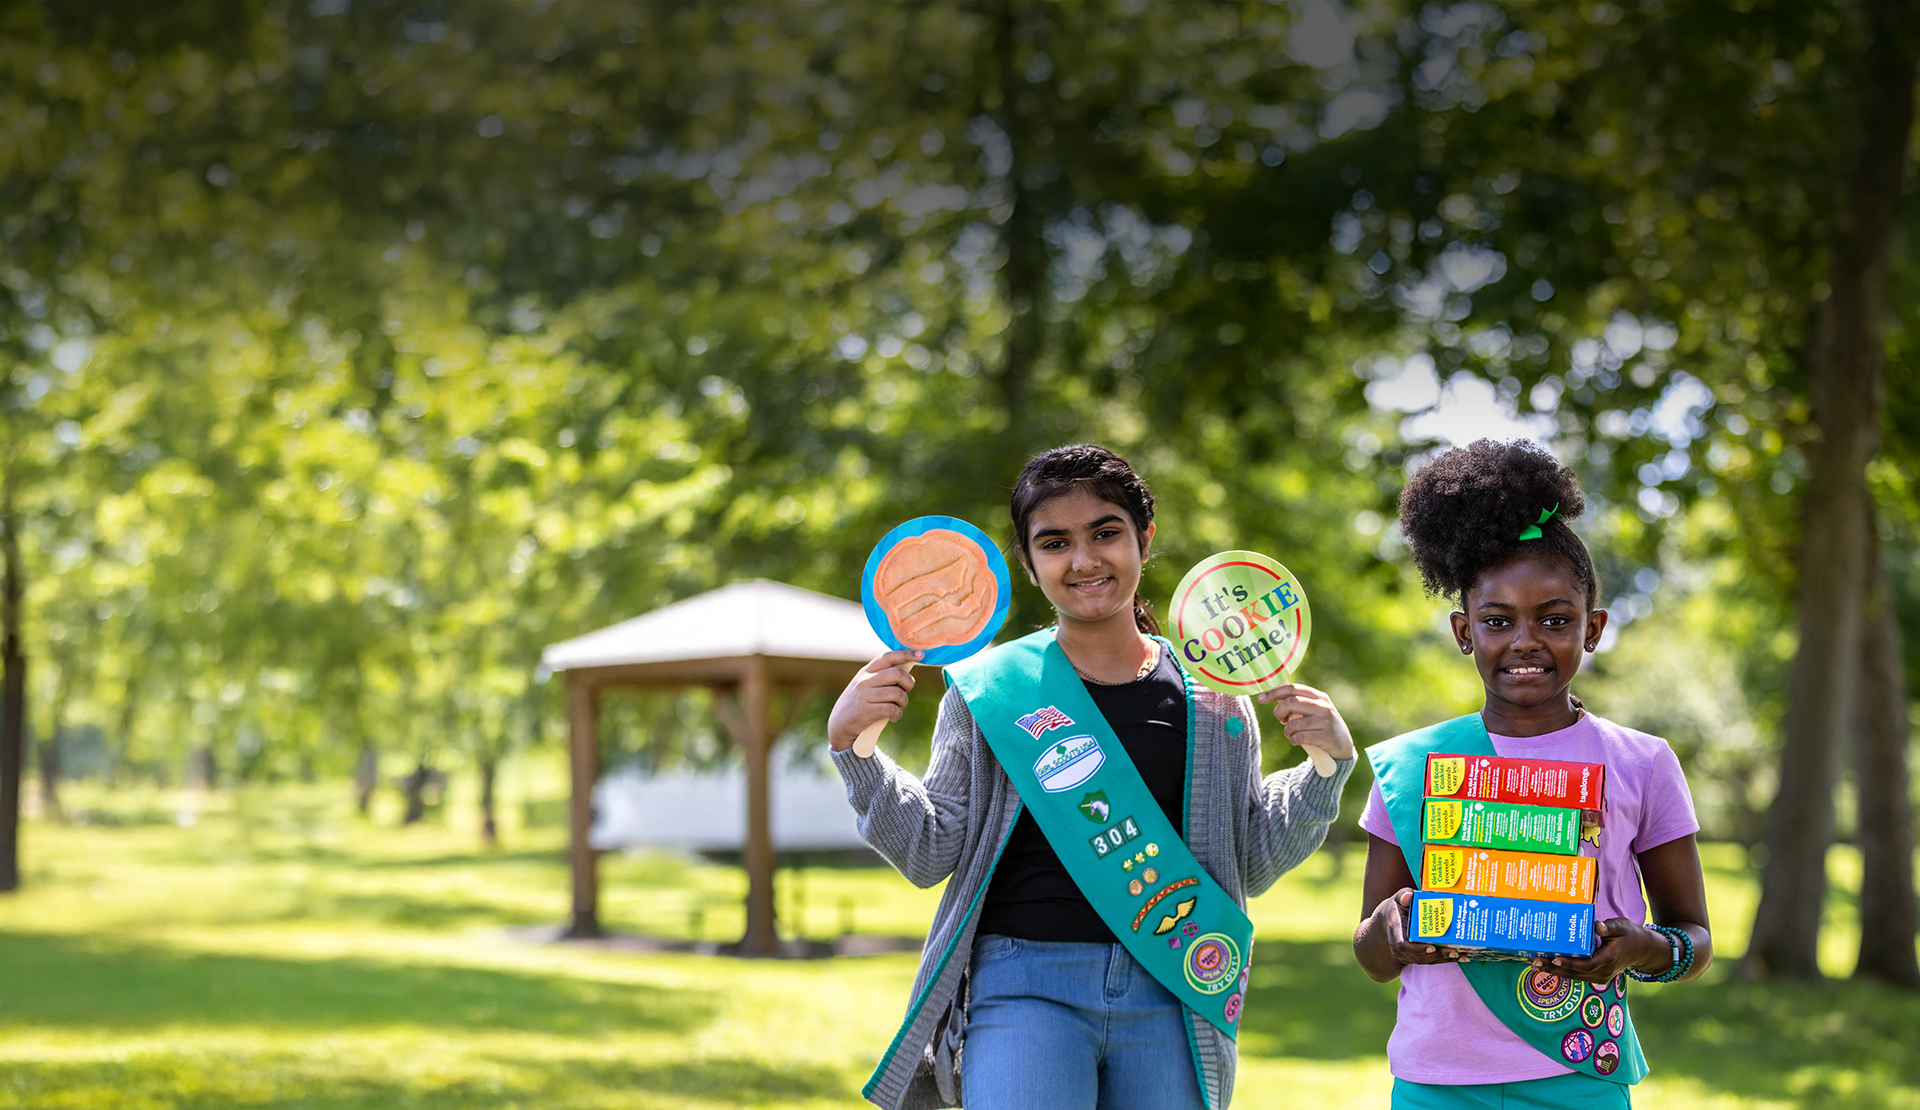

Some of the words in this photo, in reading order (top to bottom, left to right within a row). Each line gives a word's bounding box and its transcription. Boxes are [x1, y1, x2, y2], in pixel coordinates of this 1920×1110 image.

[1200, 584, 1248, 619] It's
[1184, 581, 1299, 662] COOKIE
[1216, 619, 1292, 674] Time!
[1037, 763, 1055, 776] GIRL
[1054, 748, 1081, 767] SCOUTS
[1080, 740, 1095, 752] USA
[1579, 766, 1590, 803] tagalongs.
[1094, 819, 1138, 854] 304
[1569, 860, 1578, 897] do-si-dos.
[1569, 913, 1577, 942] trefoils.
[1207, 980, 1224, 991] TRY
[1224, 956, 1238, 982] OUT!
[1537, 995, 1560, 1005] SPEAK
[1543, 1008, 1563, 1019] TRY
[1565, 982, 1582, 1010] OUT!
